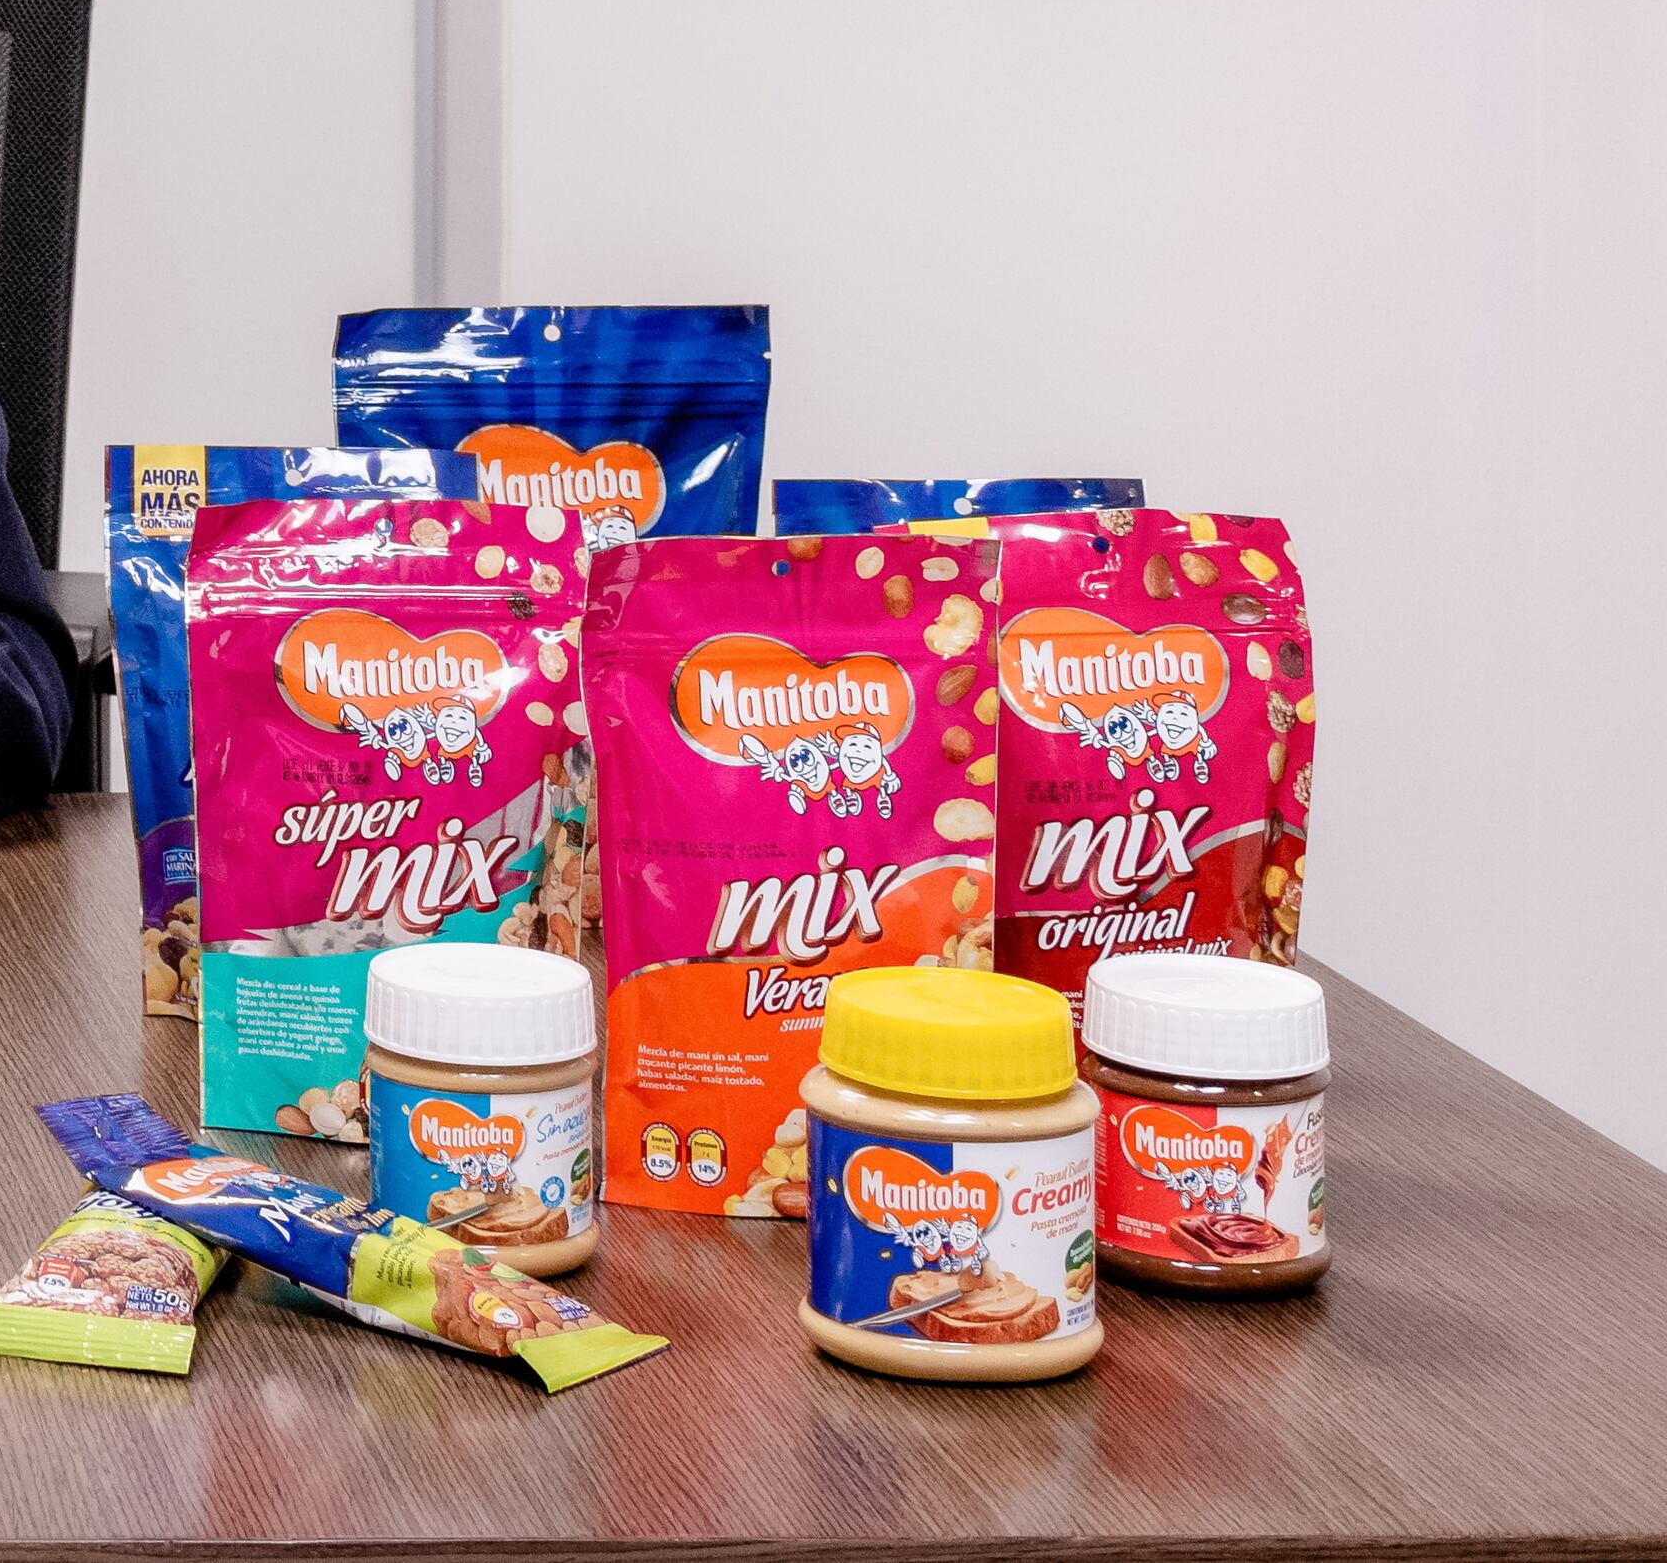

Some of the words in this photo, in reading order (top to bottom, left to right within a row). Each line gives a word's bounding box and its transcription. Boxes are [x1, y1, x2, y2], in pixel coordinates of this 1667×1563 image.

[141, 470, 199, 486] AHORA
[479, 458, 643, 508] Manitoba
[141, 487, 201, 516] MÁS
[140, 518, 193, 529] CONTENID
[303, 641, 485, 698] Manitoba
[1019, 638, 1206, 698] Manitoba
[699, 669, 890, 729] Manitoba
[274, 790, 420, 868] súper
[1024, 789, 1210, 897] mix
[330, 817, 518, 929] mix
[710, 847, 899, 962] mix
[1038, 891, 1195, 960] original
[745, 968, 832, 1017] Vera
[780, 1016, 825, 1031] summ
[638, 1044, 667, 1056] Mezcla
[712, 1052, 724, 1061] sin
[638, 1058, 675, 1069] crocante
[678, 1062, 713, 1072] picante
[637, 1068, 662, 1078] habas
[665, 1071, 699, 1082] saladas,
[725, 1076, 765, 1086] tostado,
[638, 1080, 687, 1091] almendras.
[421, 1113, 514, 1149] Manitoba
[1135, 1121, 1243, 1161] Manitoba
[650, 1159, 672, 1169] 8.5%
[698, 1165, 716, 1175] 14%
[1035, 1166, 1067, 1188] Peanut
[860, 1165, 986, 1212] Manitoba
[1012, 1168, 1093, 1216] Creamy
[1030, 1216, 1057, 1233] Pasta
[1058, 1205, 1088, 1226] cremosa
[1046, 1227, 1057, 1239] de
[43, 1278, 66, 1287] 7.5%
[128, 1291, 153, 1300] NETO
[153, 1289, 190, 1314] 50g
